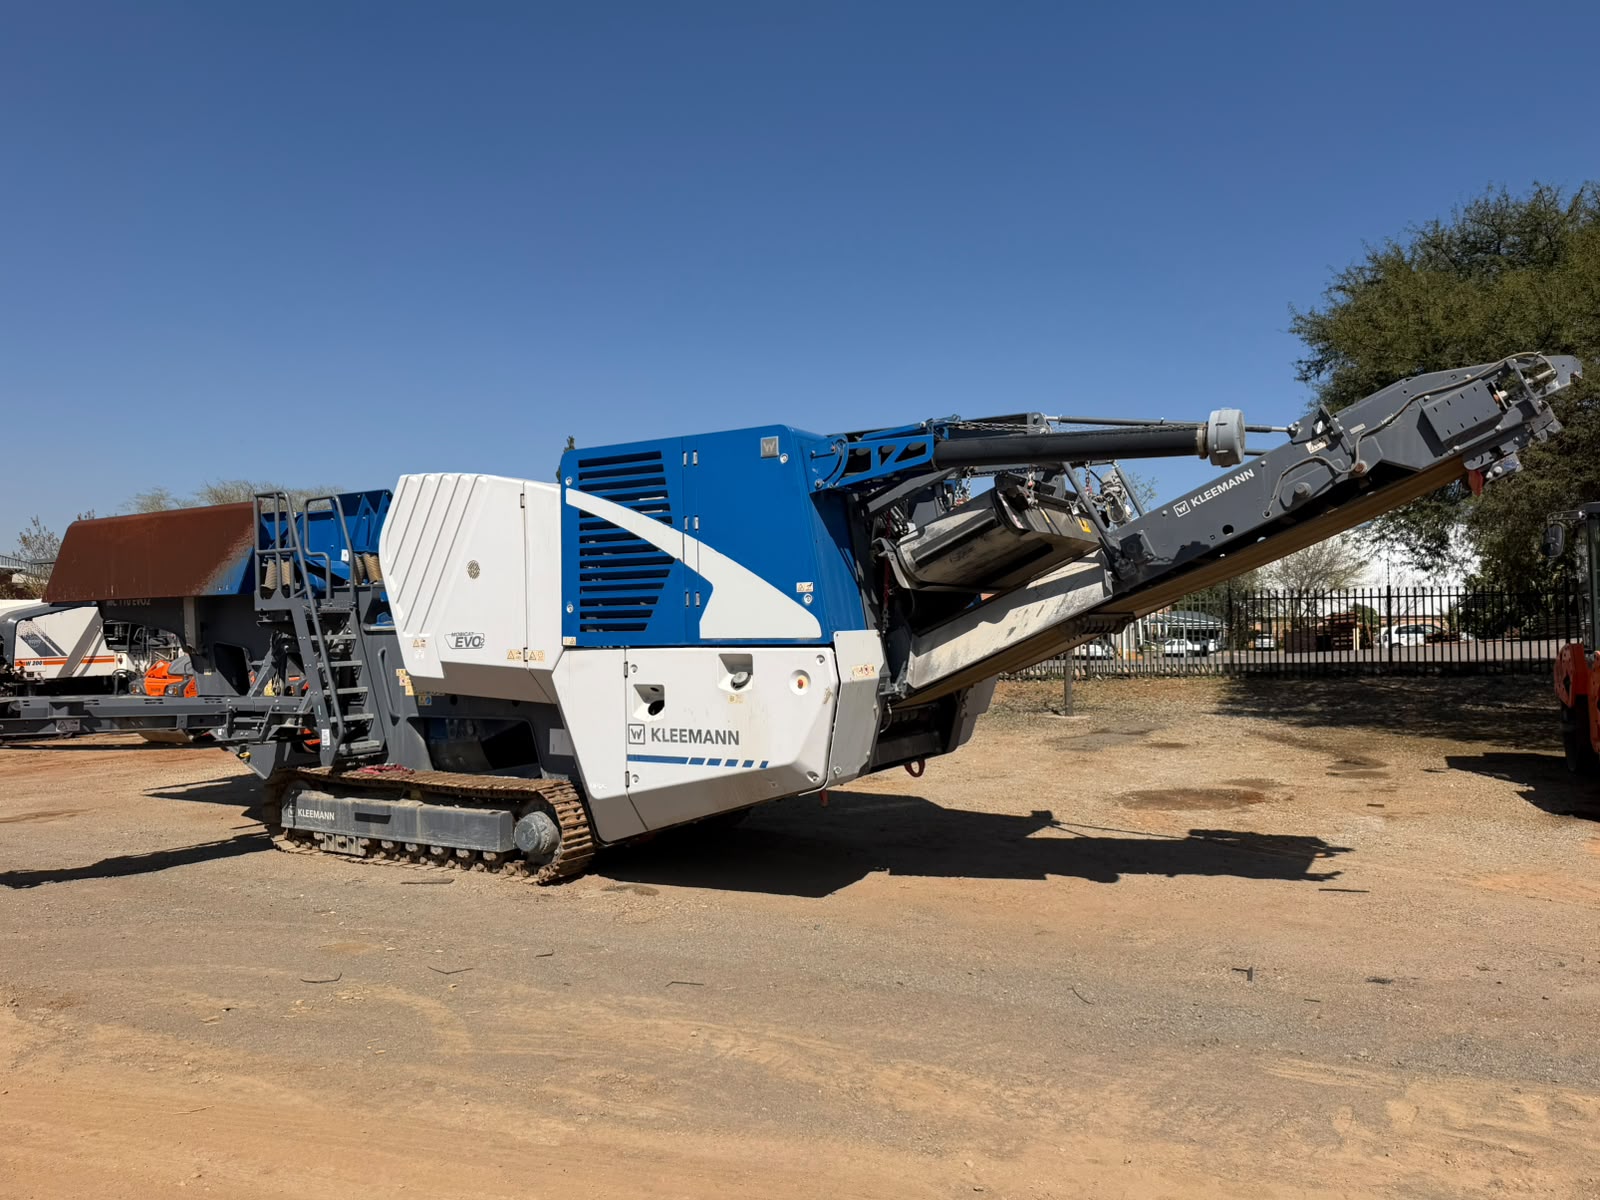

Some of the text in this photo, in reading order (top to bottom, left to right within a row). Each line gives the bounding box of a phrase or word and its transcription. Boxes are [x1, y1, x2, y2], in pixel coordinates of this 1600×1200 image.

[1190, 468, 1255, 507] KLEEMANN
[651, 727, 740, 745] KLEEMANN
[297, 808, 335, 820] KLEEMANN
